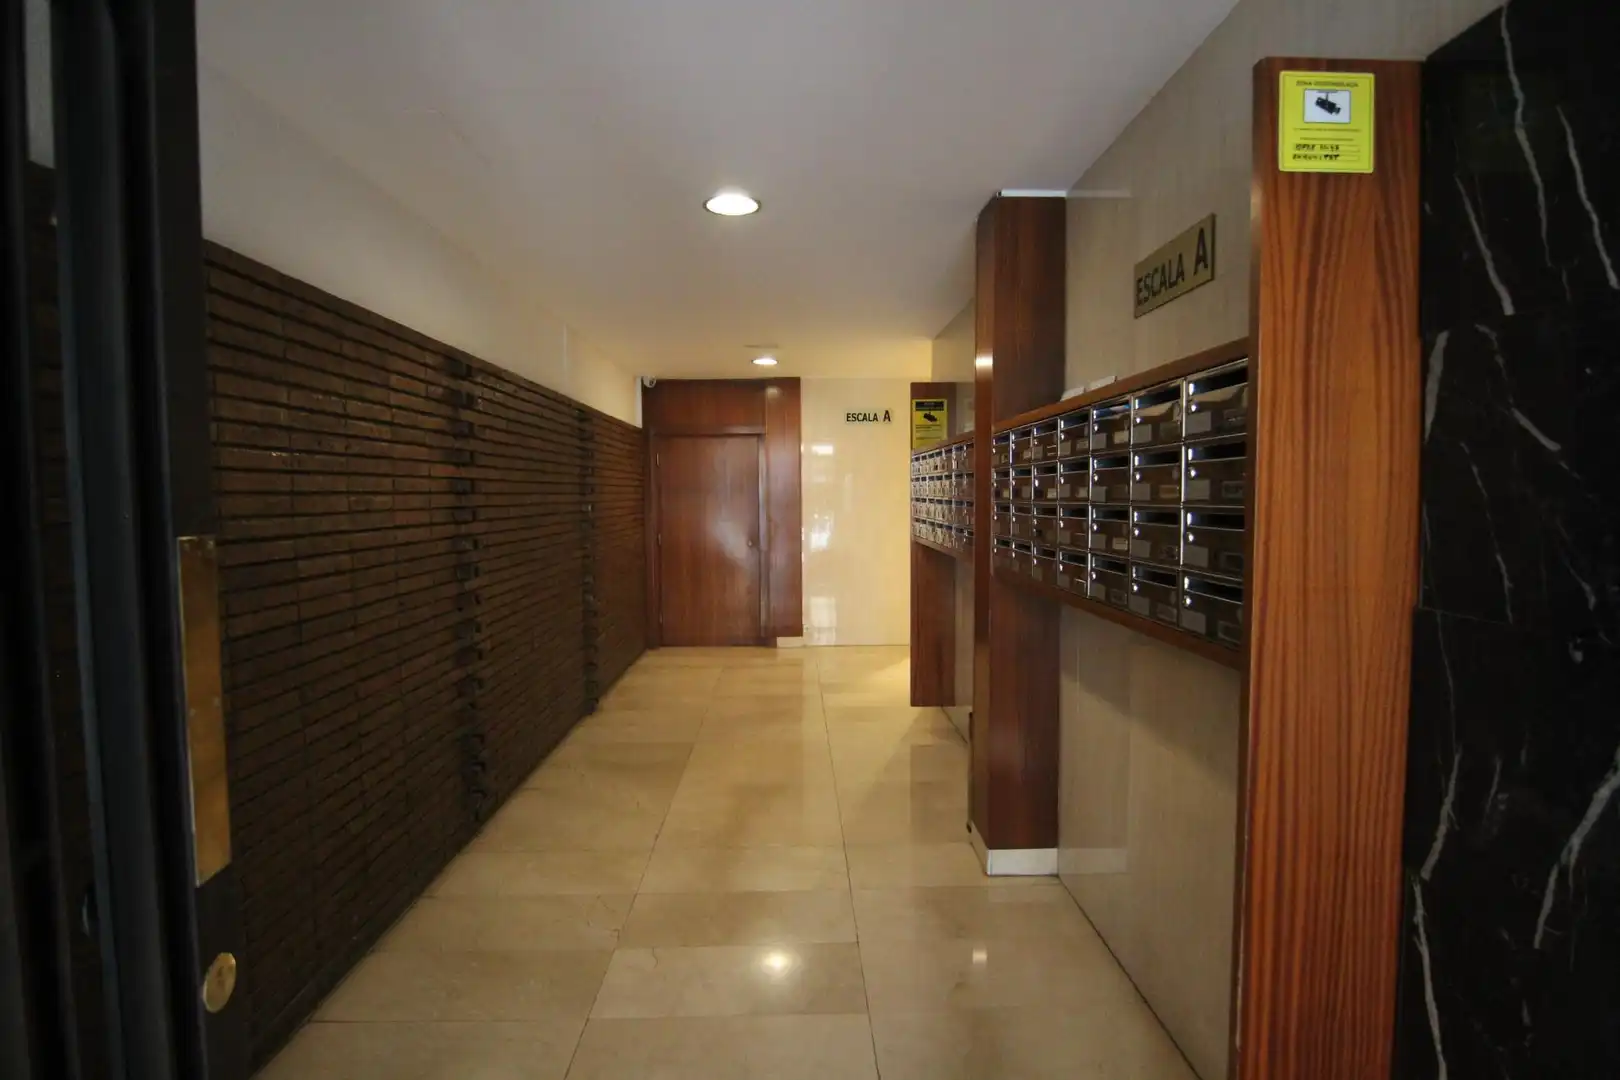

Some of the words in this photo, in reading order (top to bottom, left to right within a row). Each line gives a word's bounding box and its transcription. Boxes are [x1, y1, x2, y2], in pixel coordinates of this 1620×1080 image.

[1136, 252, 1185, 306] ESCALA
[1193, 227, 1209, 277] A
[846, 412, 879, 422] ESCALA
[883, 409, 891, 422] A
